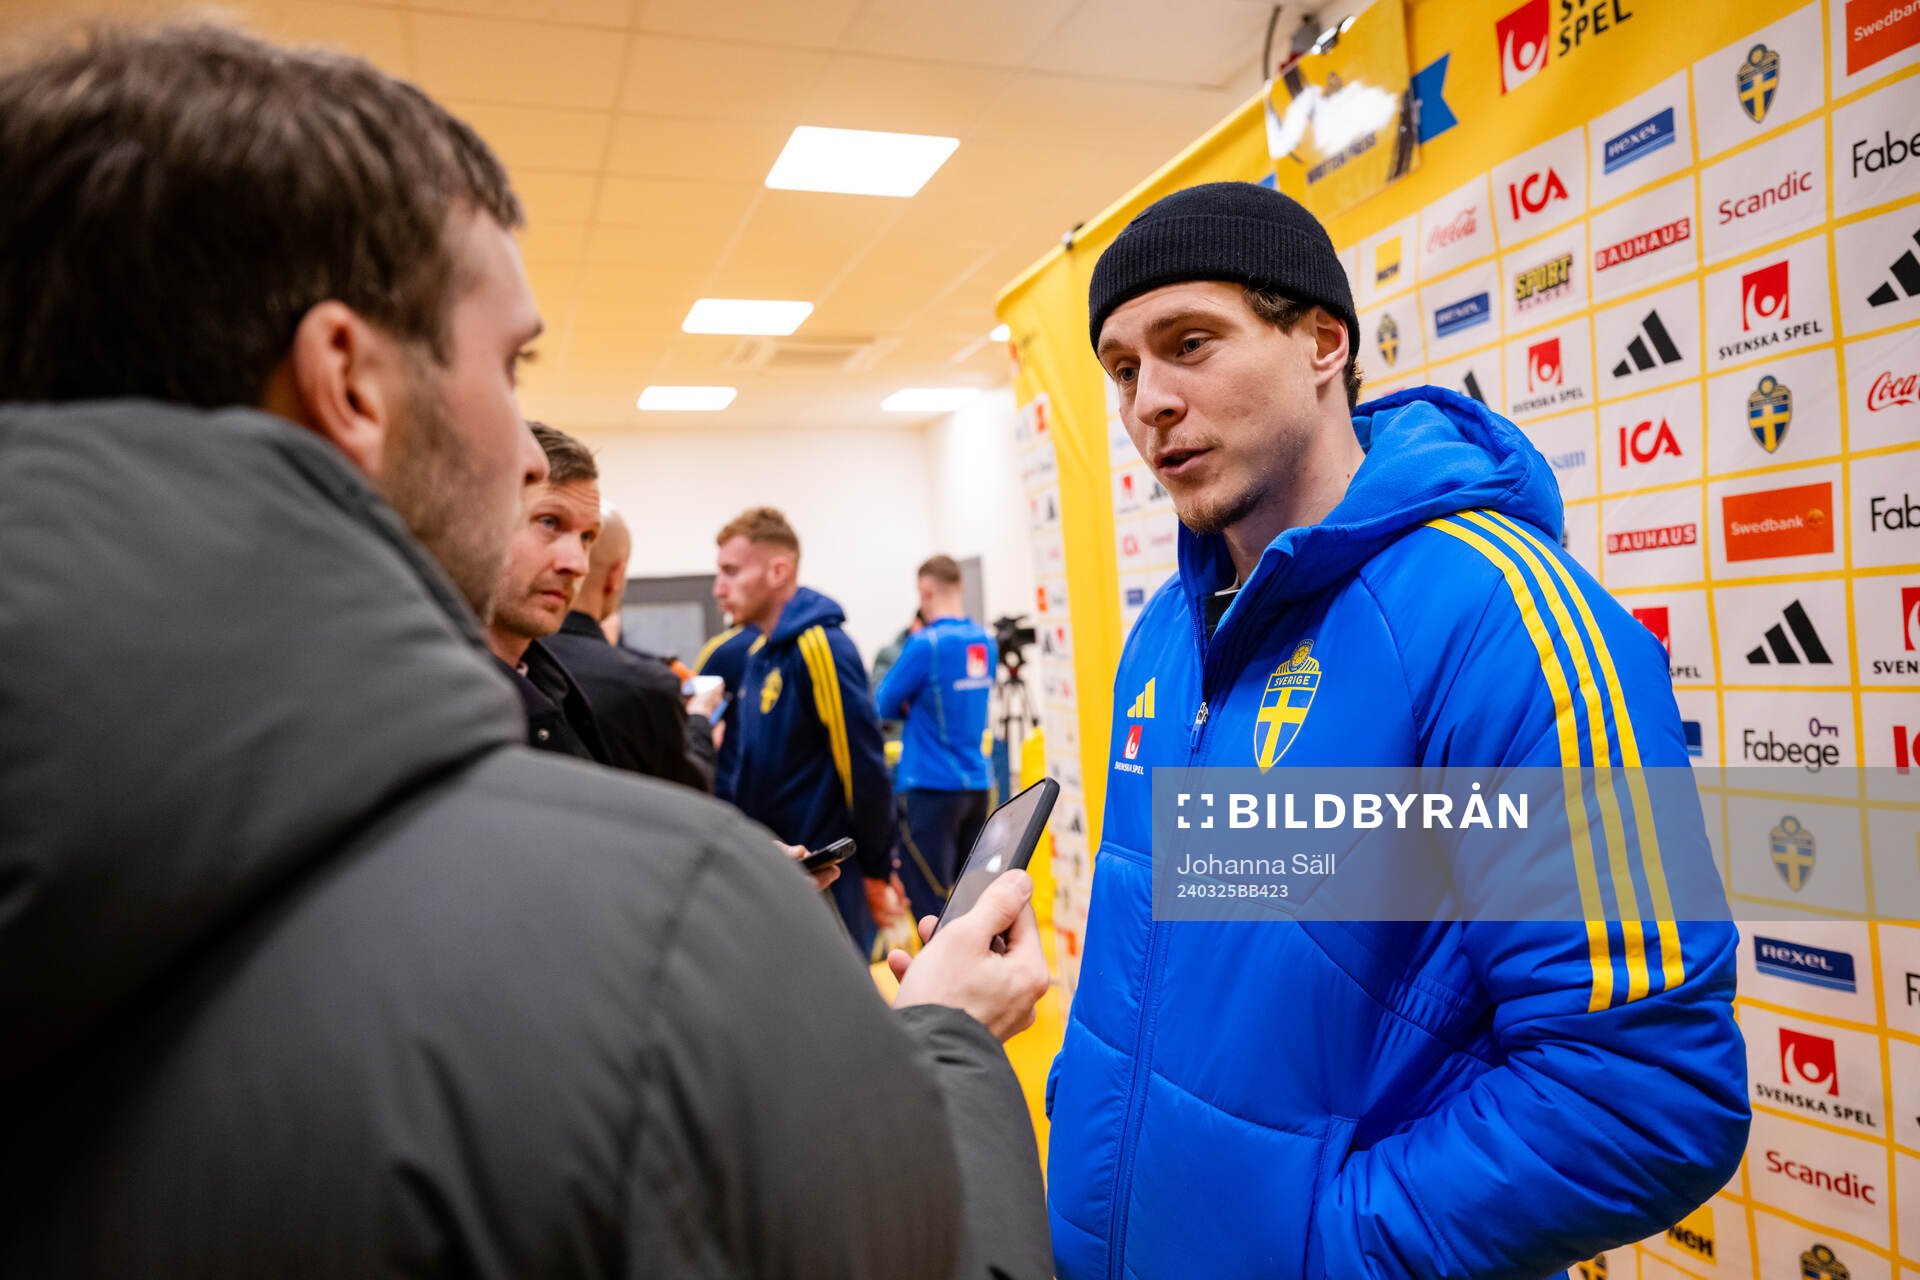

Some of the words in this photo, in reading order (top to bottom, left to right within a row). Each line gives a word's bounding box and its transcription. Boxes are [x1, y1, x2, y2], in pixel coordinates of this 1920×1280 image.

[1558, 0, 1632, 57] SPEL
[1509, 168, 1569, 221] ICA
[1718, 170, 1812, 225] Scandic
[1595, 218, 1689, 271] BAUHAUS
[1516, 254, 1572, 300] SPORT
[1719, 332, 1779, 360] SVENSKA
[1784, 320, 1823, 341] SPEL
[1619, 418, 1683, 467] ICA
[1607, 524, 1695, 553] BAUHAUS
[1731, 515, 1804, 536] Swedbank
[1274, 675, 1310, 687] SVERIGE
[1872, 660, 1920, 675] SVEN
[1744, 729, 1839, 773] Fabege
[1756, 1084, 1828, 1115] SVENSKA
[1833, 1104, 1876, 1127] SPEL
[1765, 1150, 1876, 1205] Scandic
